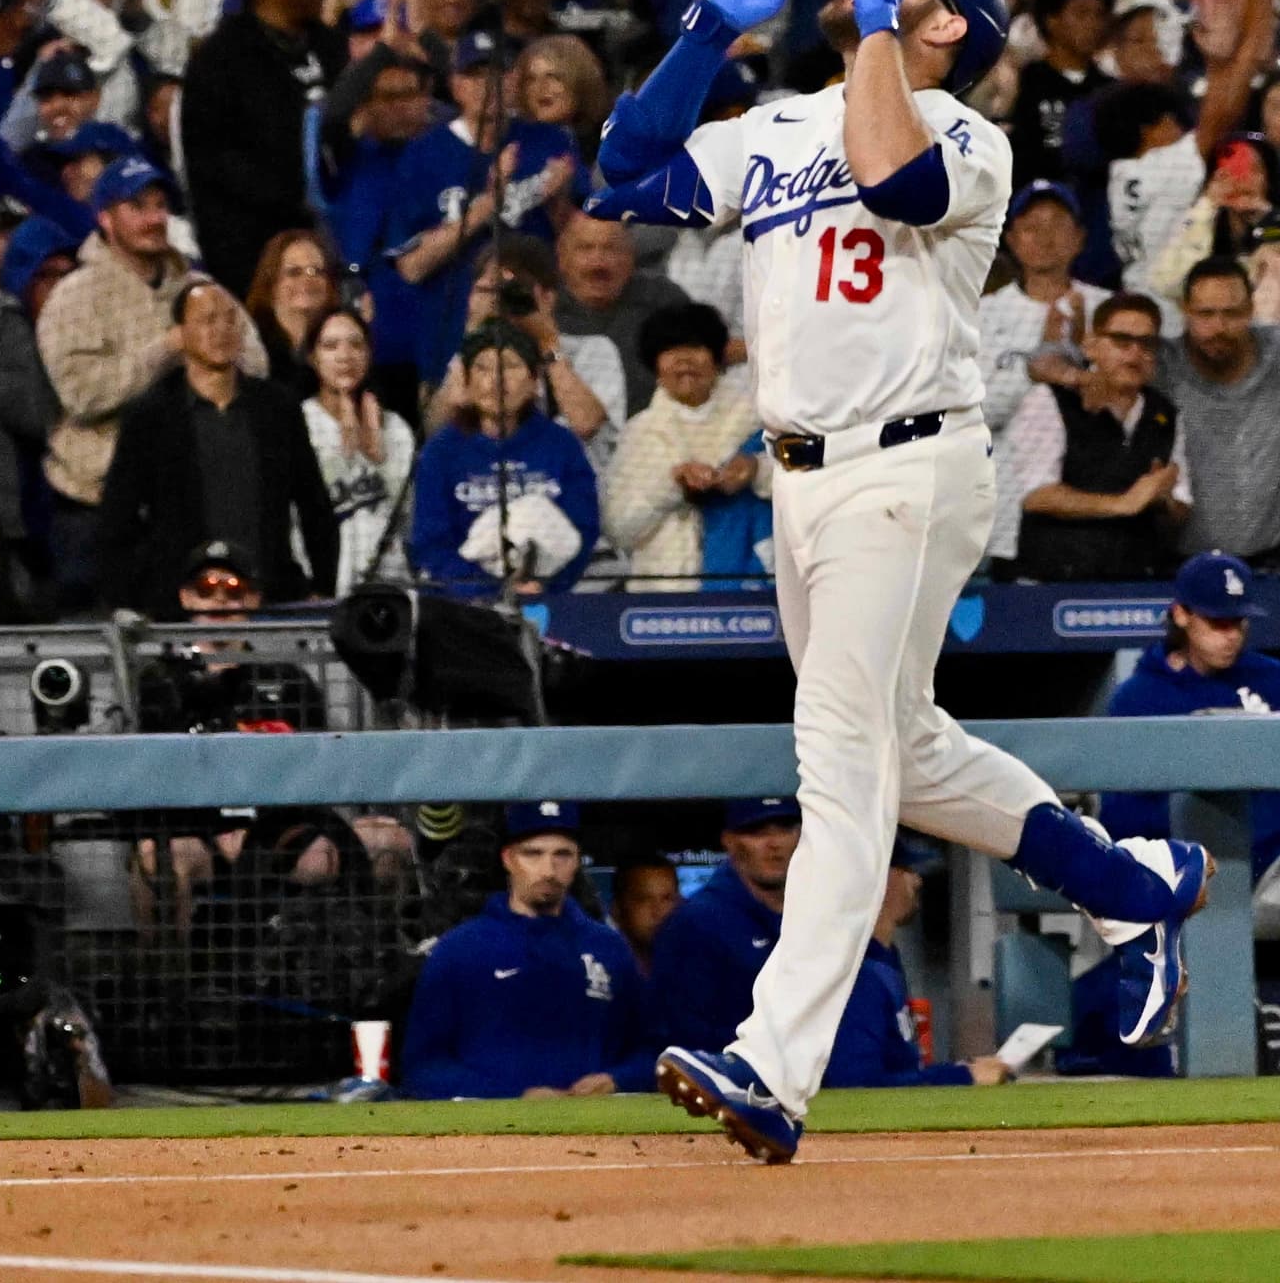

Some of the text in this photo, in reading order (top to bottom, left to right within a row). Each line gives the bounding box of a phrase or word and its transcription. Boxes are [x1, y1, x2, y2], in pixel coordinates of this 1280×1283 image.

[742, 147, 860, 244] Dodge
[816, 226, 886, 303] 13
[631, 617, 772, 635] DODGERS.COM
